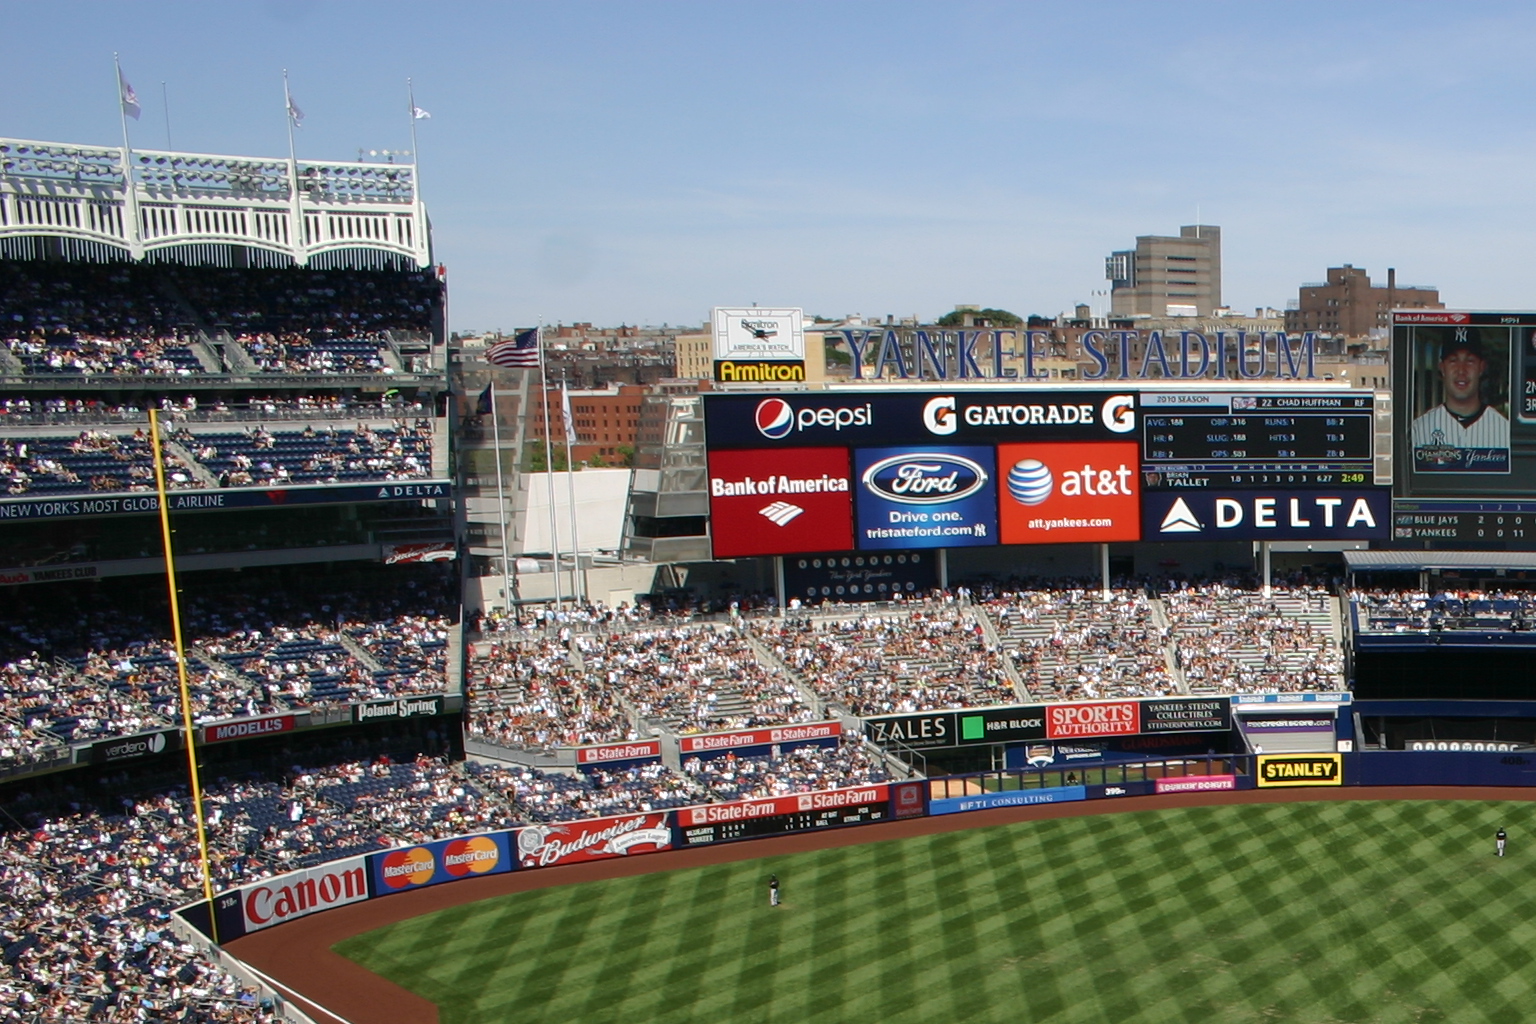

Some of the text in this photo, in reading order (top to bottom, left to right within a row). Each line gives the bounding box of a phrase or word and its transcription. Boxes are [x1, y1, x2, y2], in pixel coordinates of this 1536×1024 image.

[838, 329, 1320, 381] YANKEE STADIUM
[721, 361, 804, 381] Armitron
[1157, 395, 1210, 403] 2010 SEASON
[1262, 399, 1342, 407] 22 CHAD HUFFMAN
[797, 403, 873, 431] pepsi
[923, 395, 1136, 435] G GATORADE G
[711, 473, 849, 497] Bank of America
[891, 462, 960, 496] Ford
[1060, 464, 1133, 496] at&t
[1167, 473, 1365, 487] TALLET 2:49
[394, 485, 443, 496] DELTA
[0, 504, 31, 517] NEW
[35, 501, 80, 516] YORK'S
[83, 500, 120, 513] MOST
[177, 494, 225, 509] AIRLINE
[1215, 497, 1377, 528] DELTA
[889, 510, 964, 523] Drive one.
[1028, 516, 1112, 530] att.yankees.com
[1414, 515, 1458, 525] BLUE JAYS
[866, 523, 972, 539] tristateford.com
[1414, 528, 1524, 537] YANKEES 11
[32, 567, 72, 580] YANKEES
[74, 566, 97, 578] CLUB
[357, 698, 437, 722] Poland Spring
[1052, 704, 1133, 724] SPORTS
[1156, 710, 1214, 719] COLLECTIBLES
[216, 717, 283, 738] MODELL'S
[875, 717, 947, 742] ZALES
[986, 717, 1042, 731] H&R BLOCK
[1147, 720, 1222, 730] STEINERSPORTS.COM
[704, 734, 754, 748] State Farm
[782, 726, 830, 741] State Farm
[598, 745, 650, 760] State Farm
[1266, 763, 1333, 777] STANLEY
[1199, 780, 1233, 790] DONUTS
[813, 790, 877, 808] State Farm
[992, 794, 1054, 807] CONSULTING
[708, 805, 743, 822] State
[742, 802, 775, 818] Farm
[533, 815, 647, 867] Budweiser
[446, 848, 498, 867] MasterCard
[384, 858, 435, 879] MasterCard
[245, 866, 366, 925] Canon
